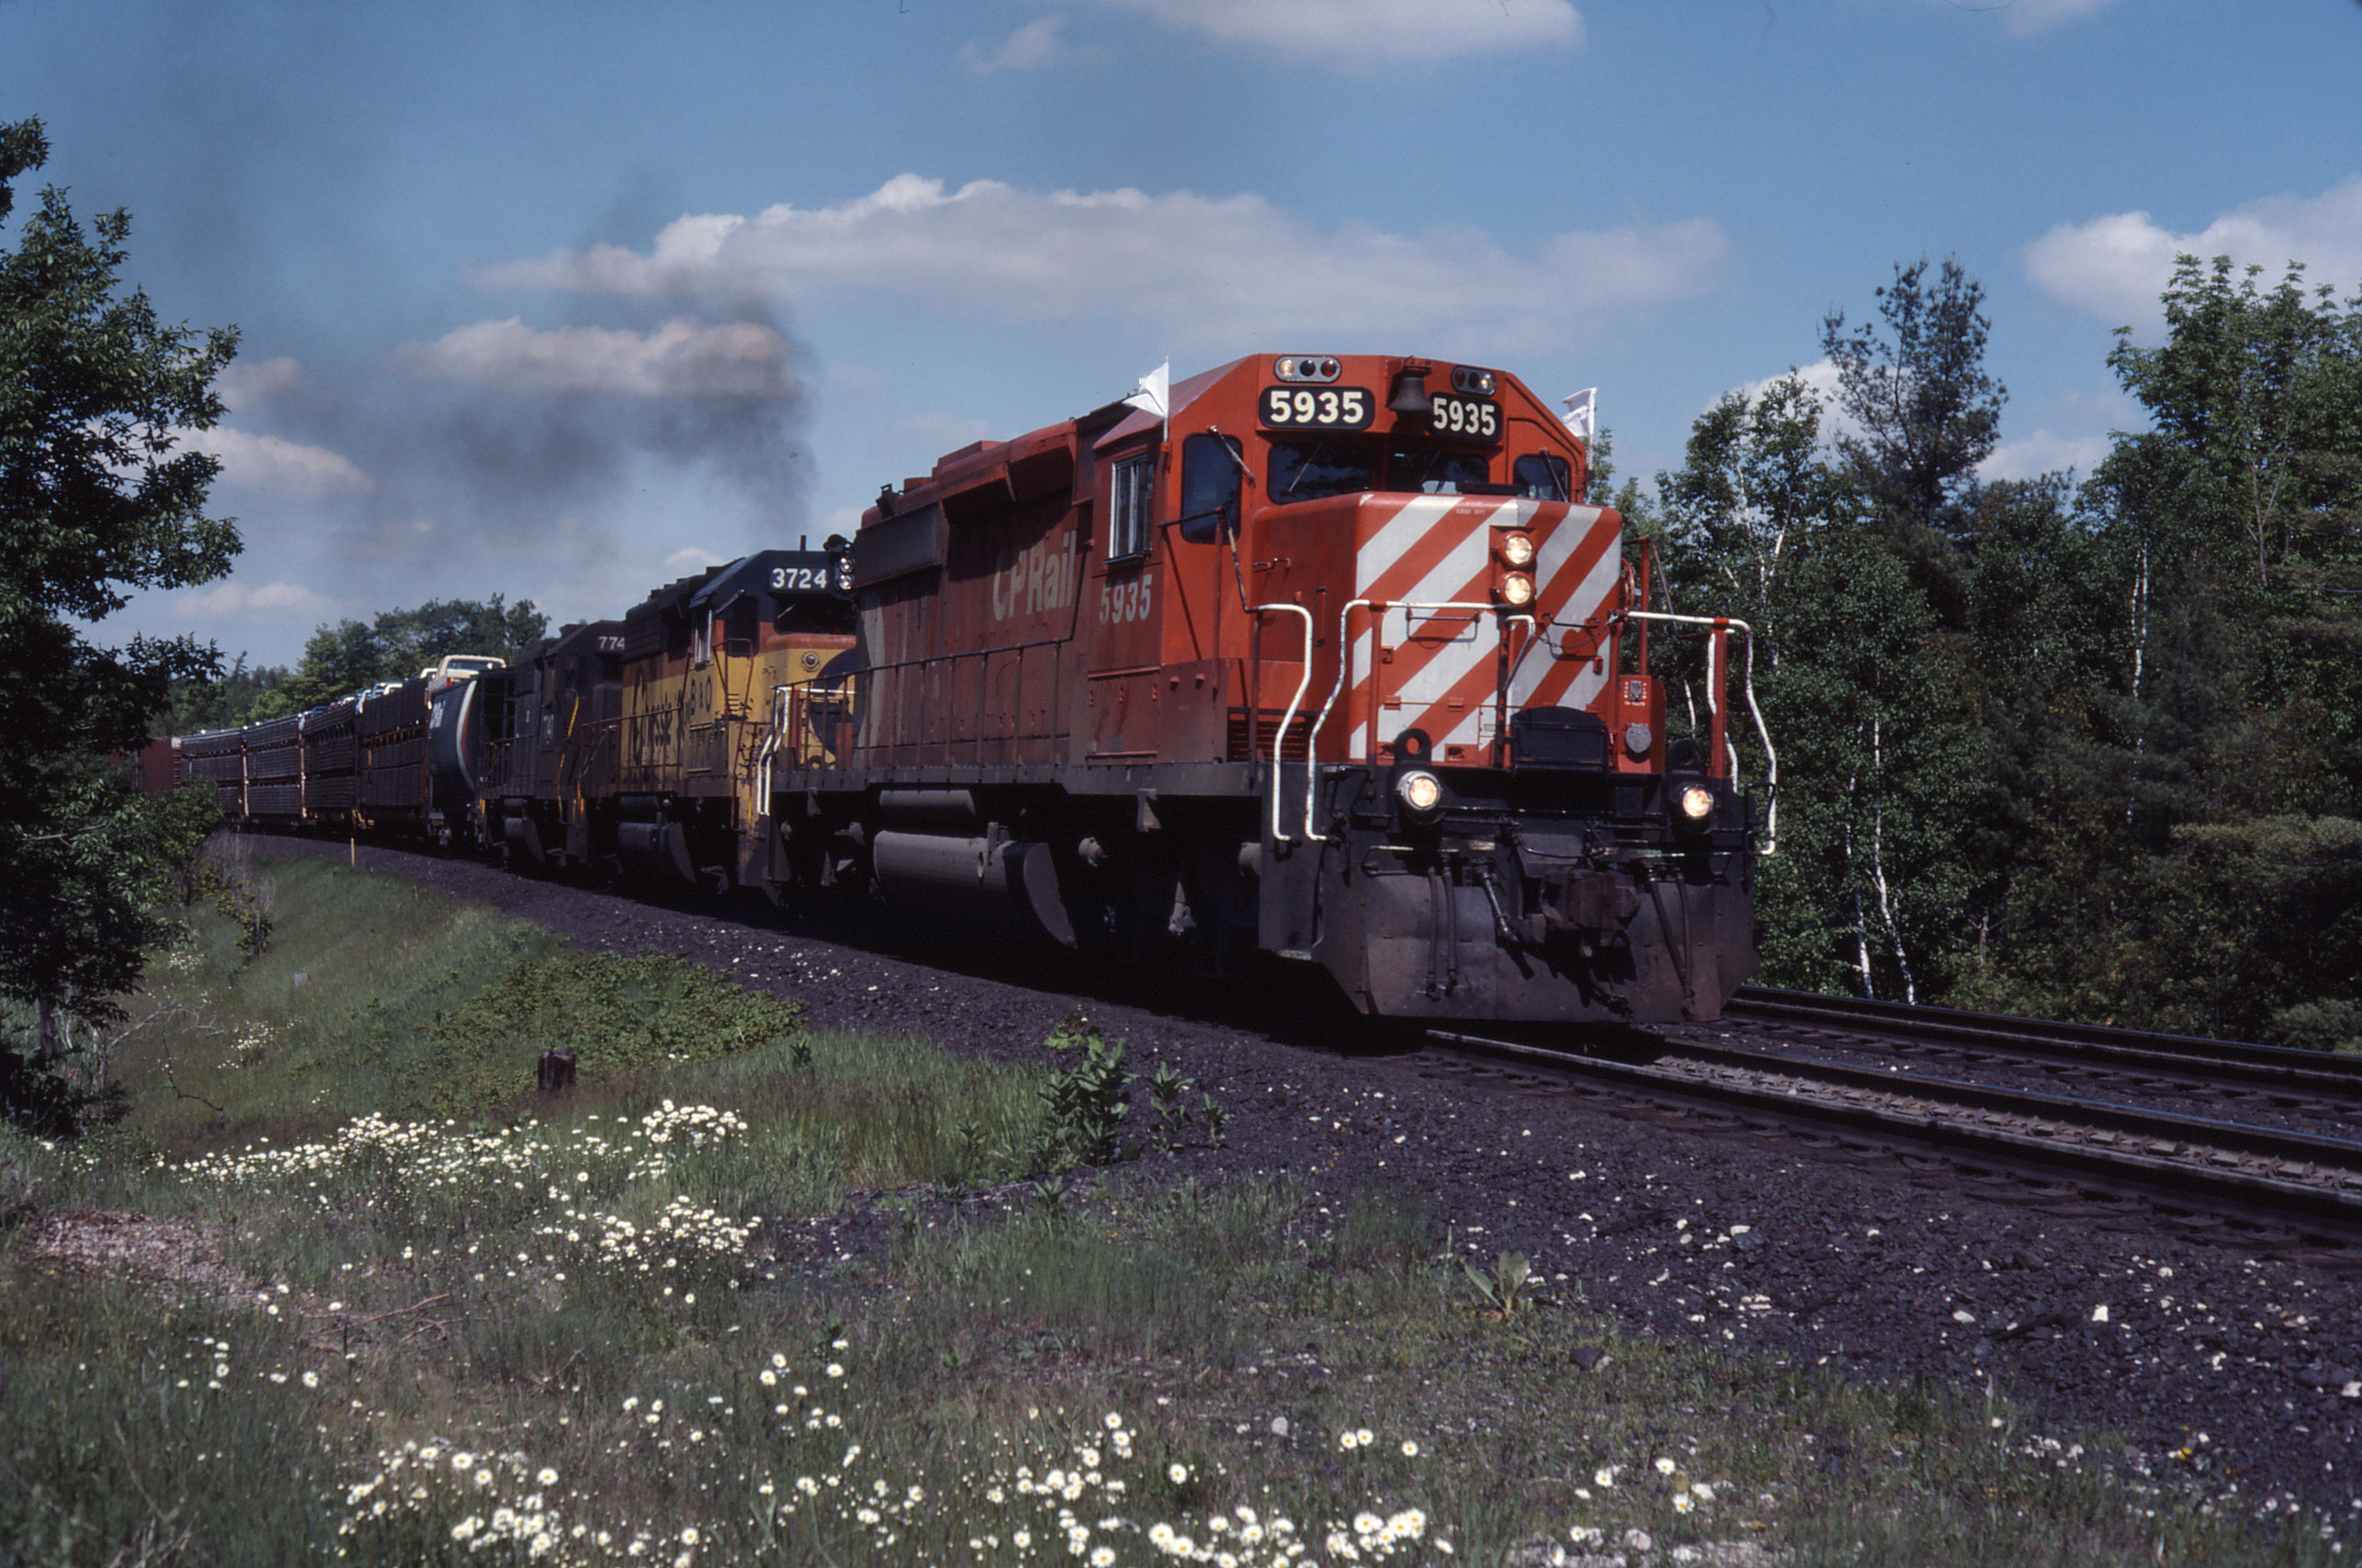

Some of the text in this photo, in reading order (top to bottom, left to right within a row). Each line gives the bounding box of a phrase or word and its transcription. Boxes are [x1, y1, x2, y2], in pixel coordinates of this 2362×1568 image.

[1270, 390, 1364, 423] 5935
[1433, 397, 1496, 436] 5935
[772, 567, 828, 589] 3724
[1098, 573, 1153, 626] 5935
